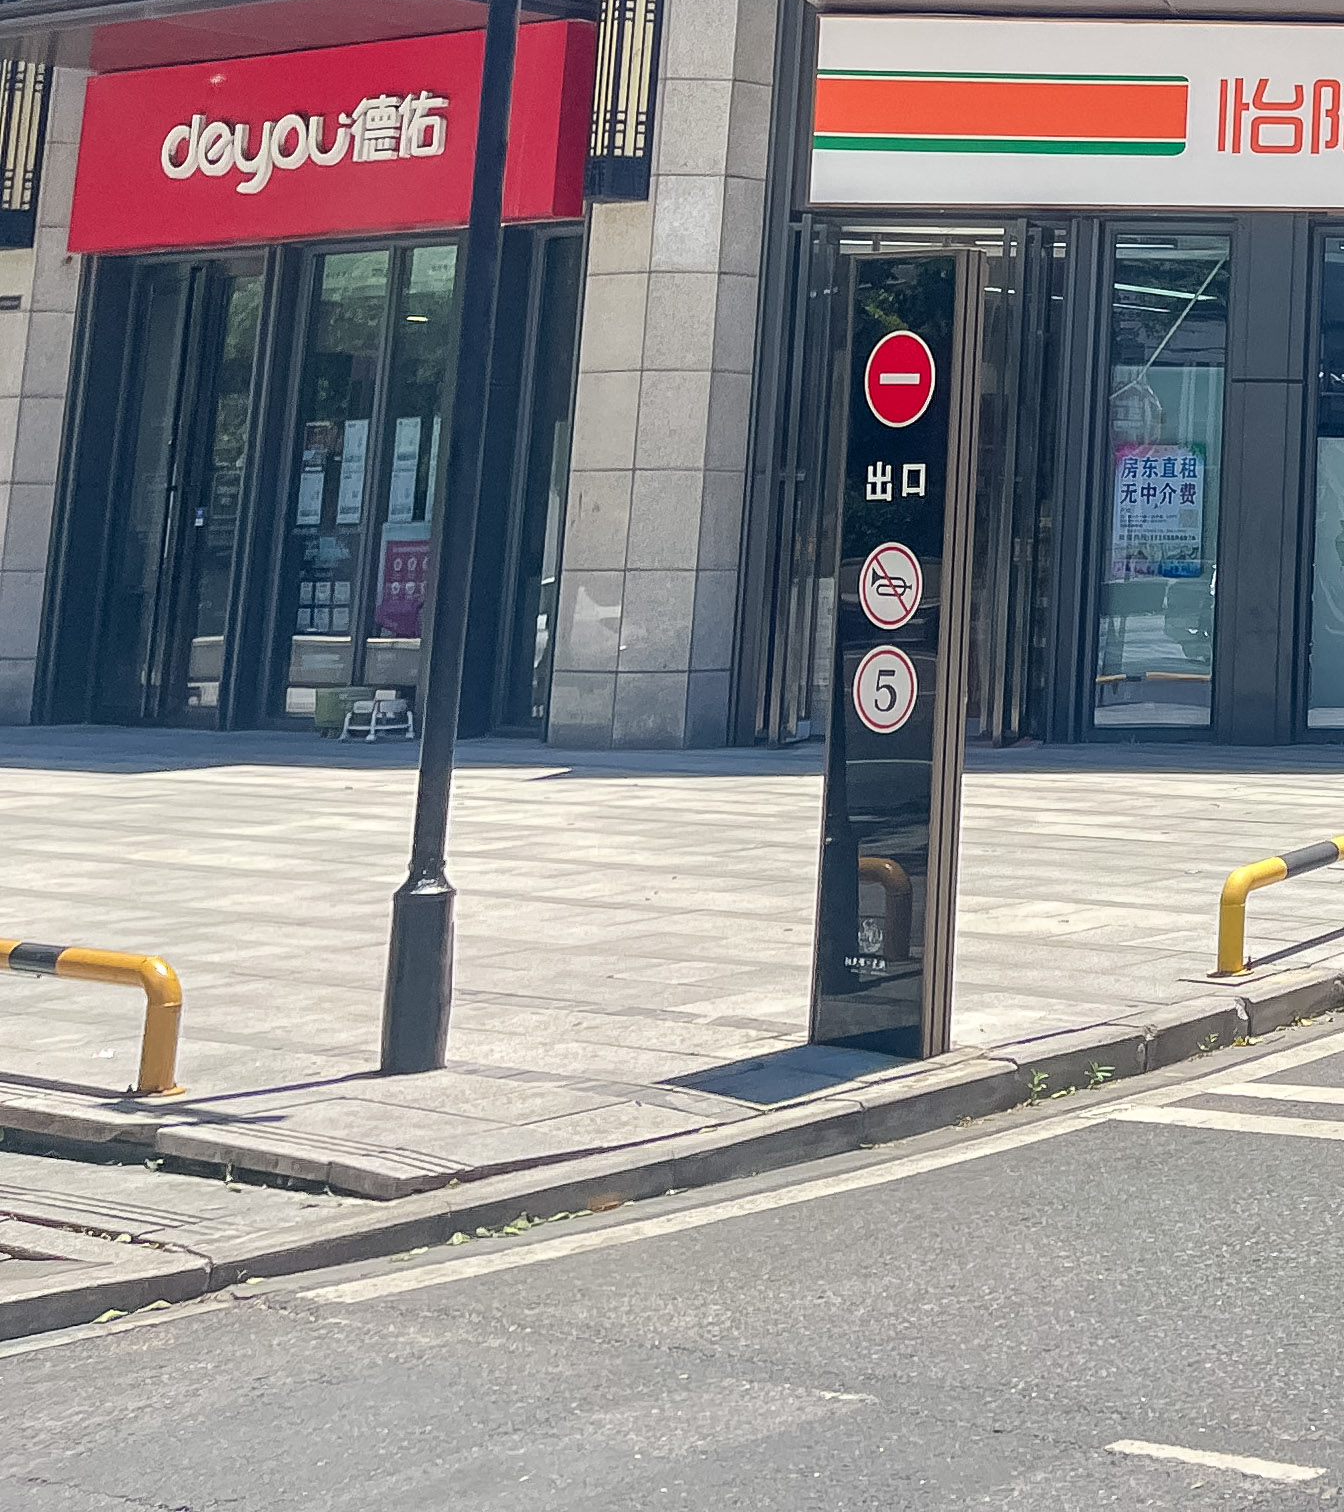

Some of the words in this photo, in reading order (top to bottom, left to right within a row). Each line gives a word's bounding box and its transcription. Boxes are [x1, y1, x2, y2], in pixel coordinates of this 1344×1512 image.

[160, 112, 352, 195] deyou
[351, 90, 449, 163] 德佑
[864, 460, 926, 503] 出口
[1120, 456, 1198, 479] 房东直租
[1119, 482, 1197, 505] 无中介费
[874, 668, 898, 713] 5
